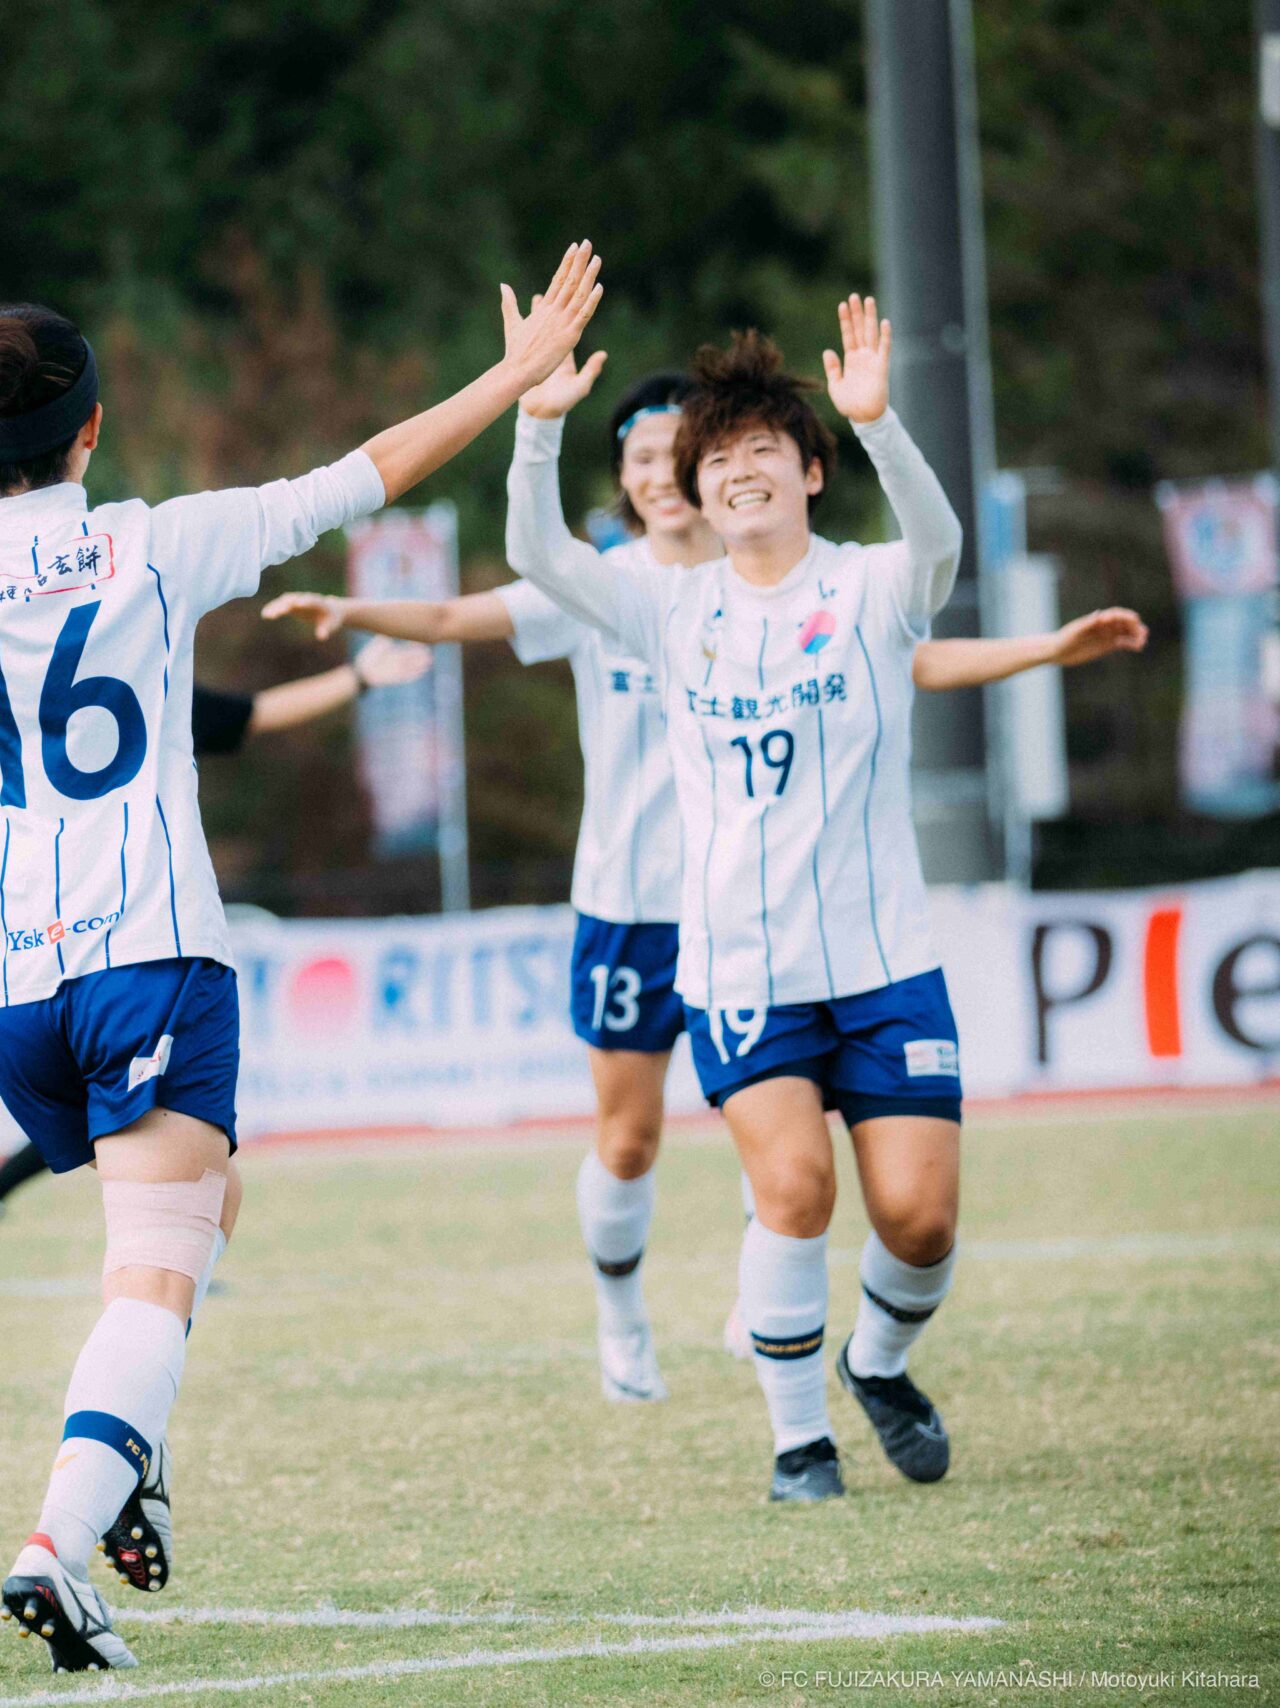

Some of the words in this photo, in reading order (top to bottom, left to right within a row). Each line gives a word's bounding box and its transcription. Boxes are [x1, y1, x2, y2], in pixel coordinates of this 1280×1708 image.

[730, 729, 794, 798] 19
[590, 964, 642, 1032] 13
[707, 1006, 767, 1065] 19
